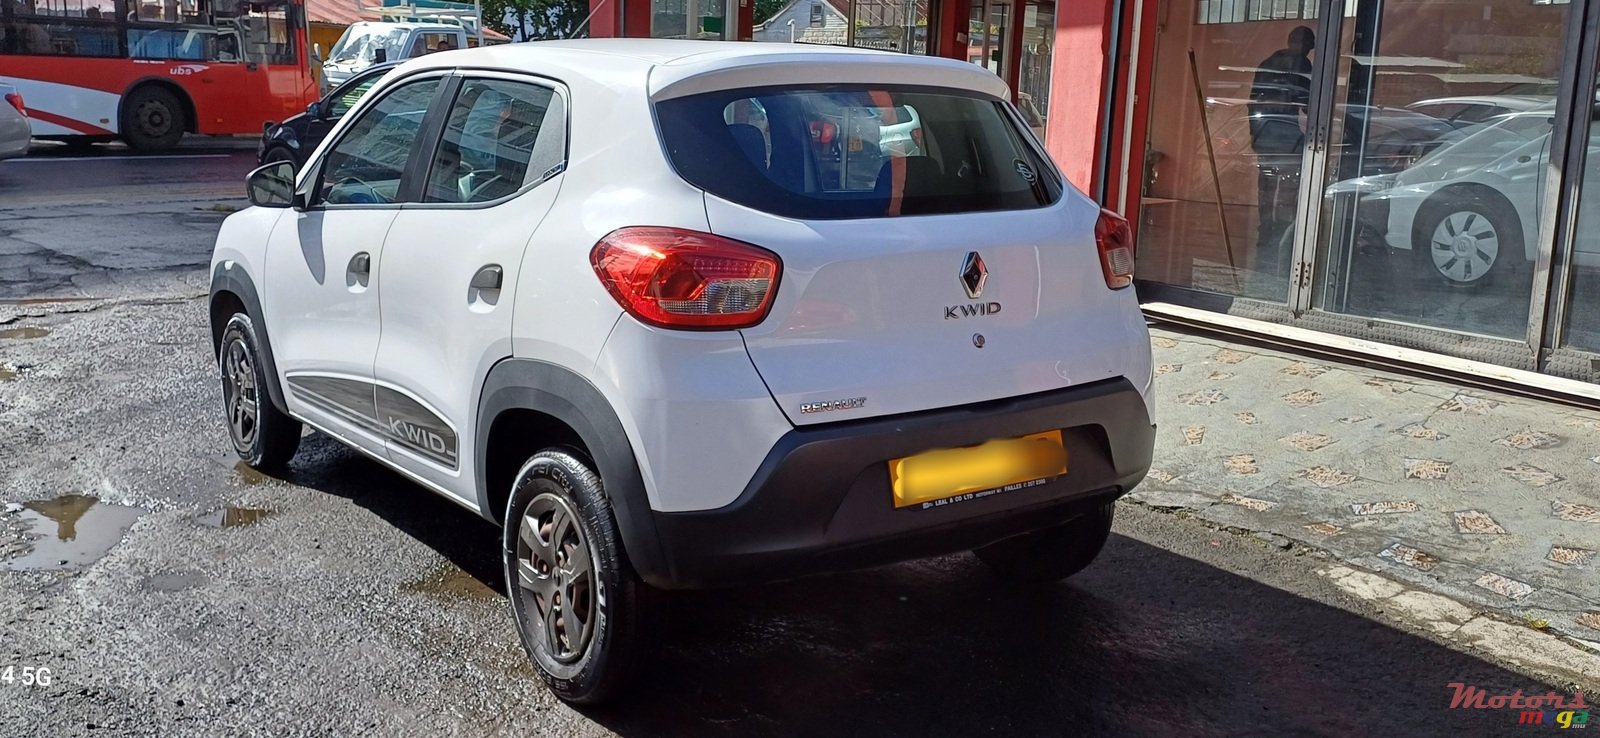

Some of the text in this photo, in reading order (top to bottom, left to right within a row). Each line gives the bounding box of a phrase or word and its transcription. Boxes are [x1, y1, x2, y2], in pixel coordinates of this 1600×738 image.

[169, 66, 192, 75] ubs
[943, 302, 1002, 320] KWID
[800, 397, 867, 414] RENAULT
[388, 415, 446, 453] KWID
[935, 499, 948, 507] LEAL
[954, 495, 963, 503] CO
[963, 493, 974, 501] LTD
